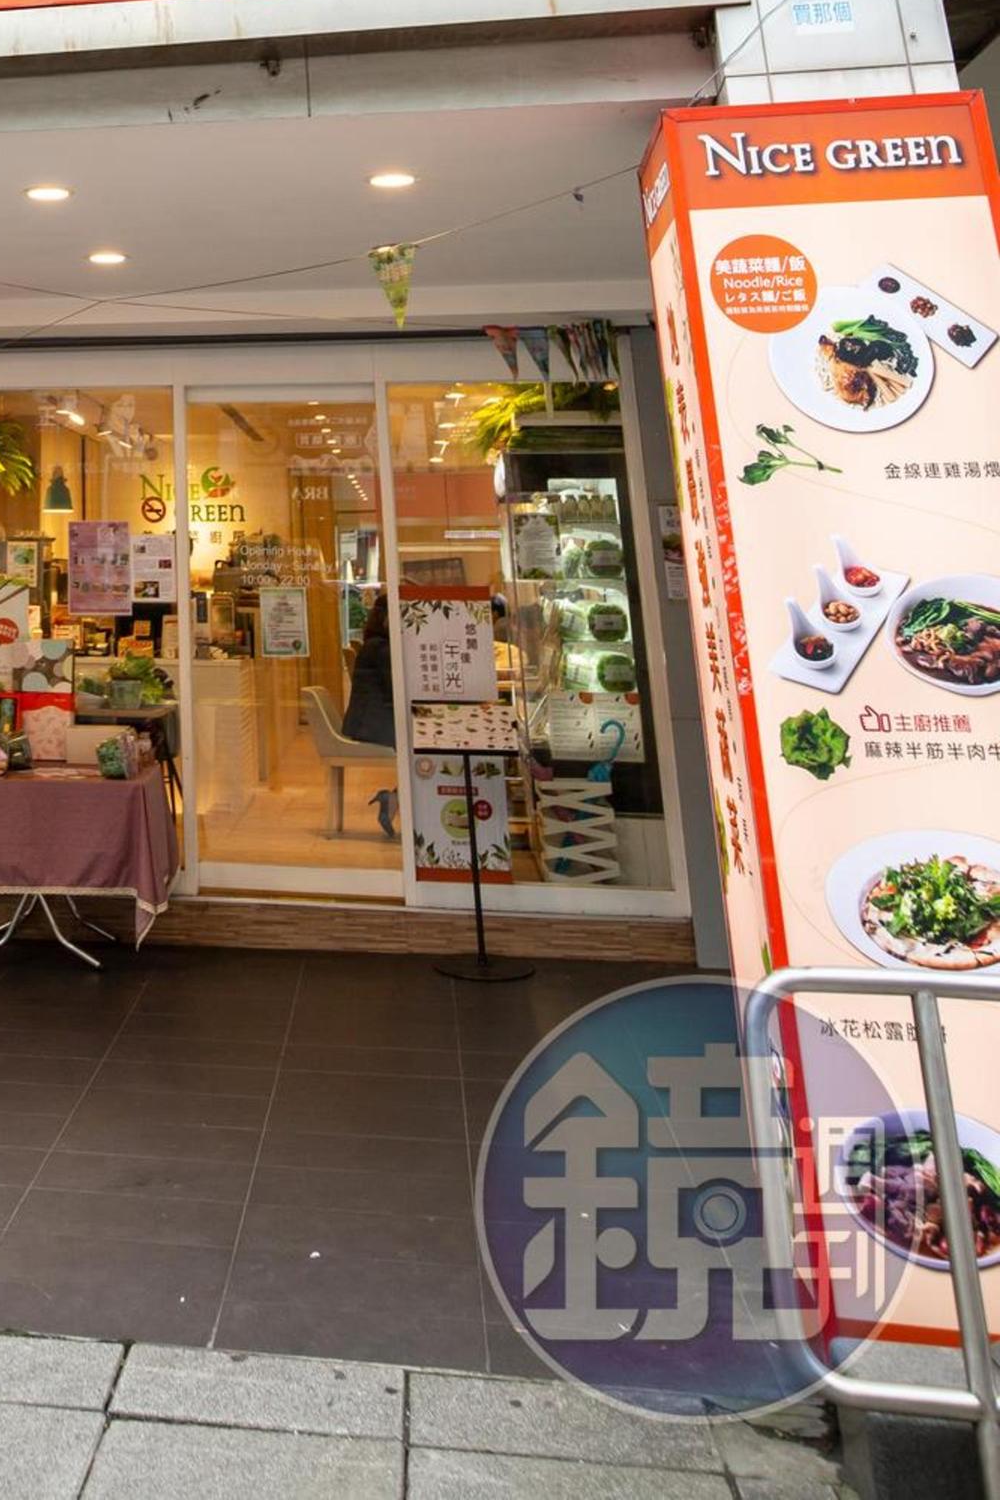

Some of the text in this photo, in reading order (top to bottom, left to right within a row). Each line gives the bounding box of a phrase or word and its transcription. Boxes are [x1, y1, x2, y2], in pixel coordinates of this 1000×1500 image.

[697, 132, 815, 176] NICE
[723, 275, 804, 289] Noodle/Rice
[139, 474, 200, 501] NIE
[894, 713, 971, 733] 主廚推薦
